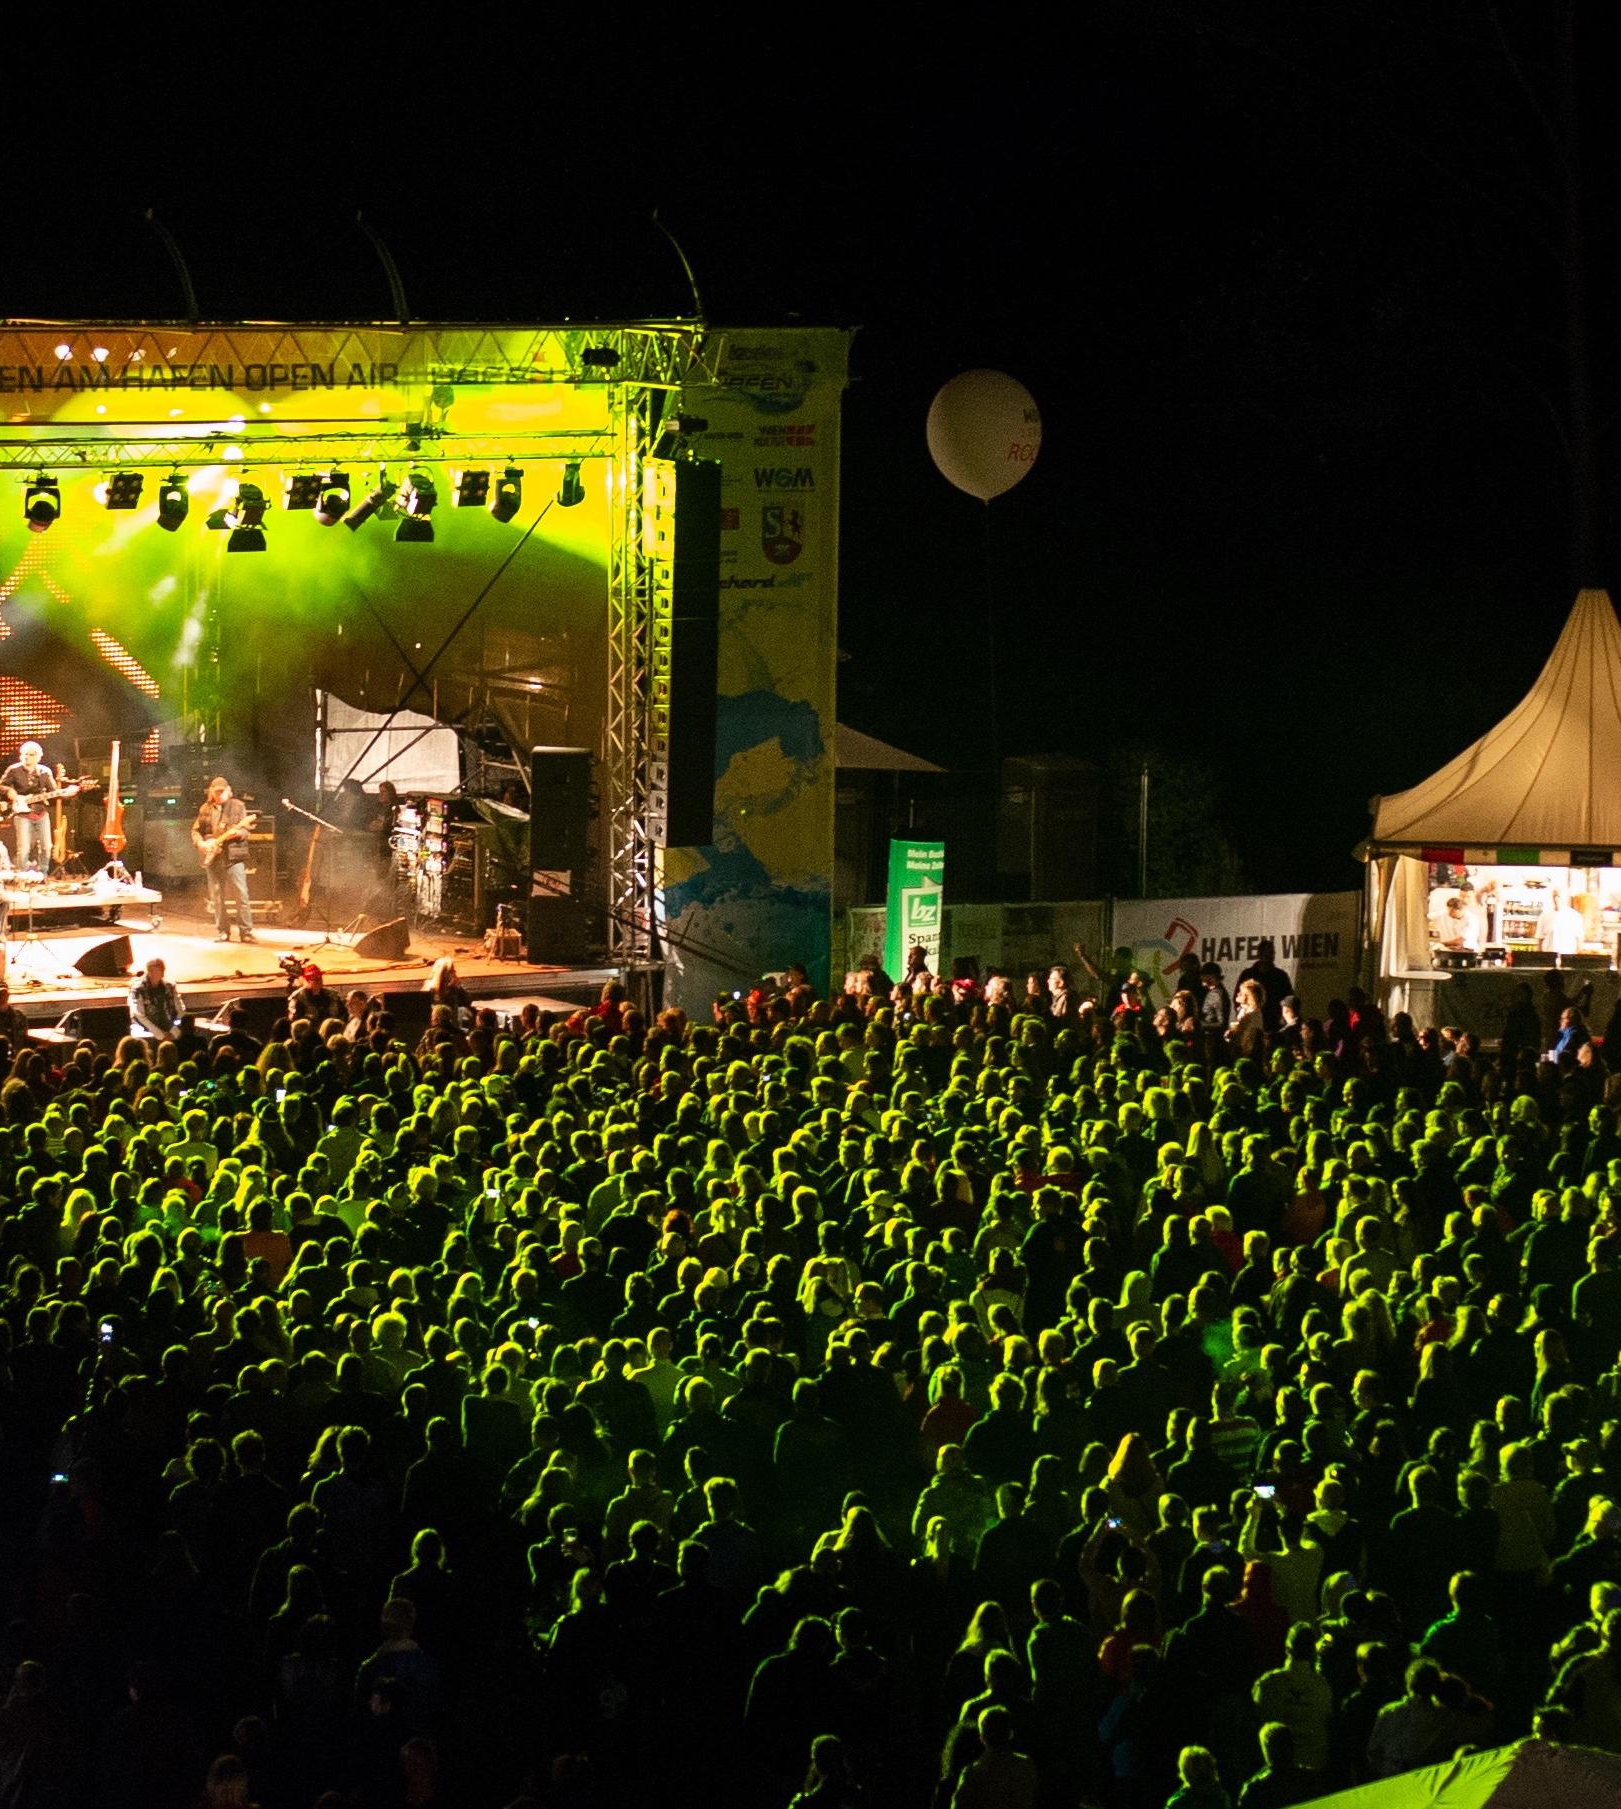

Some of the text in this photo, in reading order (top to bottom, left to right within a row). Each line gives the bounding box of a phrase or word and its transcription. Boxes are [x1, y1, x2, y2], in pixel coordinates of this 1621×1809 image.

[53, 363, 109, 392] AM
[122, 363, 234, 392] HAFEN
[245, 362, 335, 391] OPEN
[348, 361, 400, 390] AIR
[753, 466, 815, 488] WGM
[720, 572, 776, 589] chard
[911, 897, 936, 922] bz
[1281, 932, 1339, 959] WIEN
